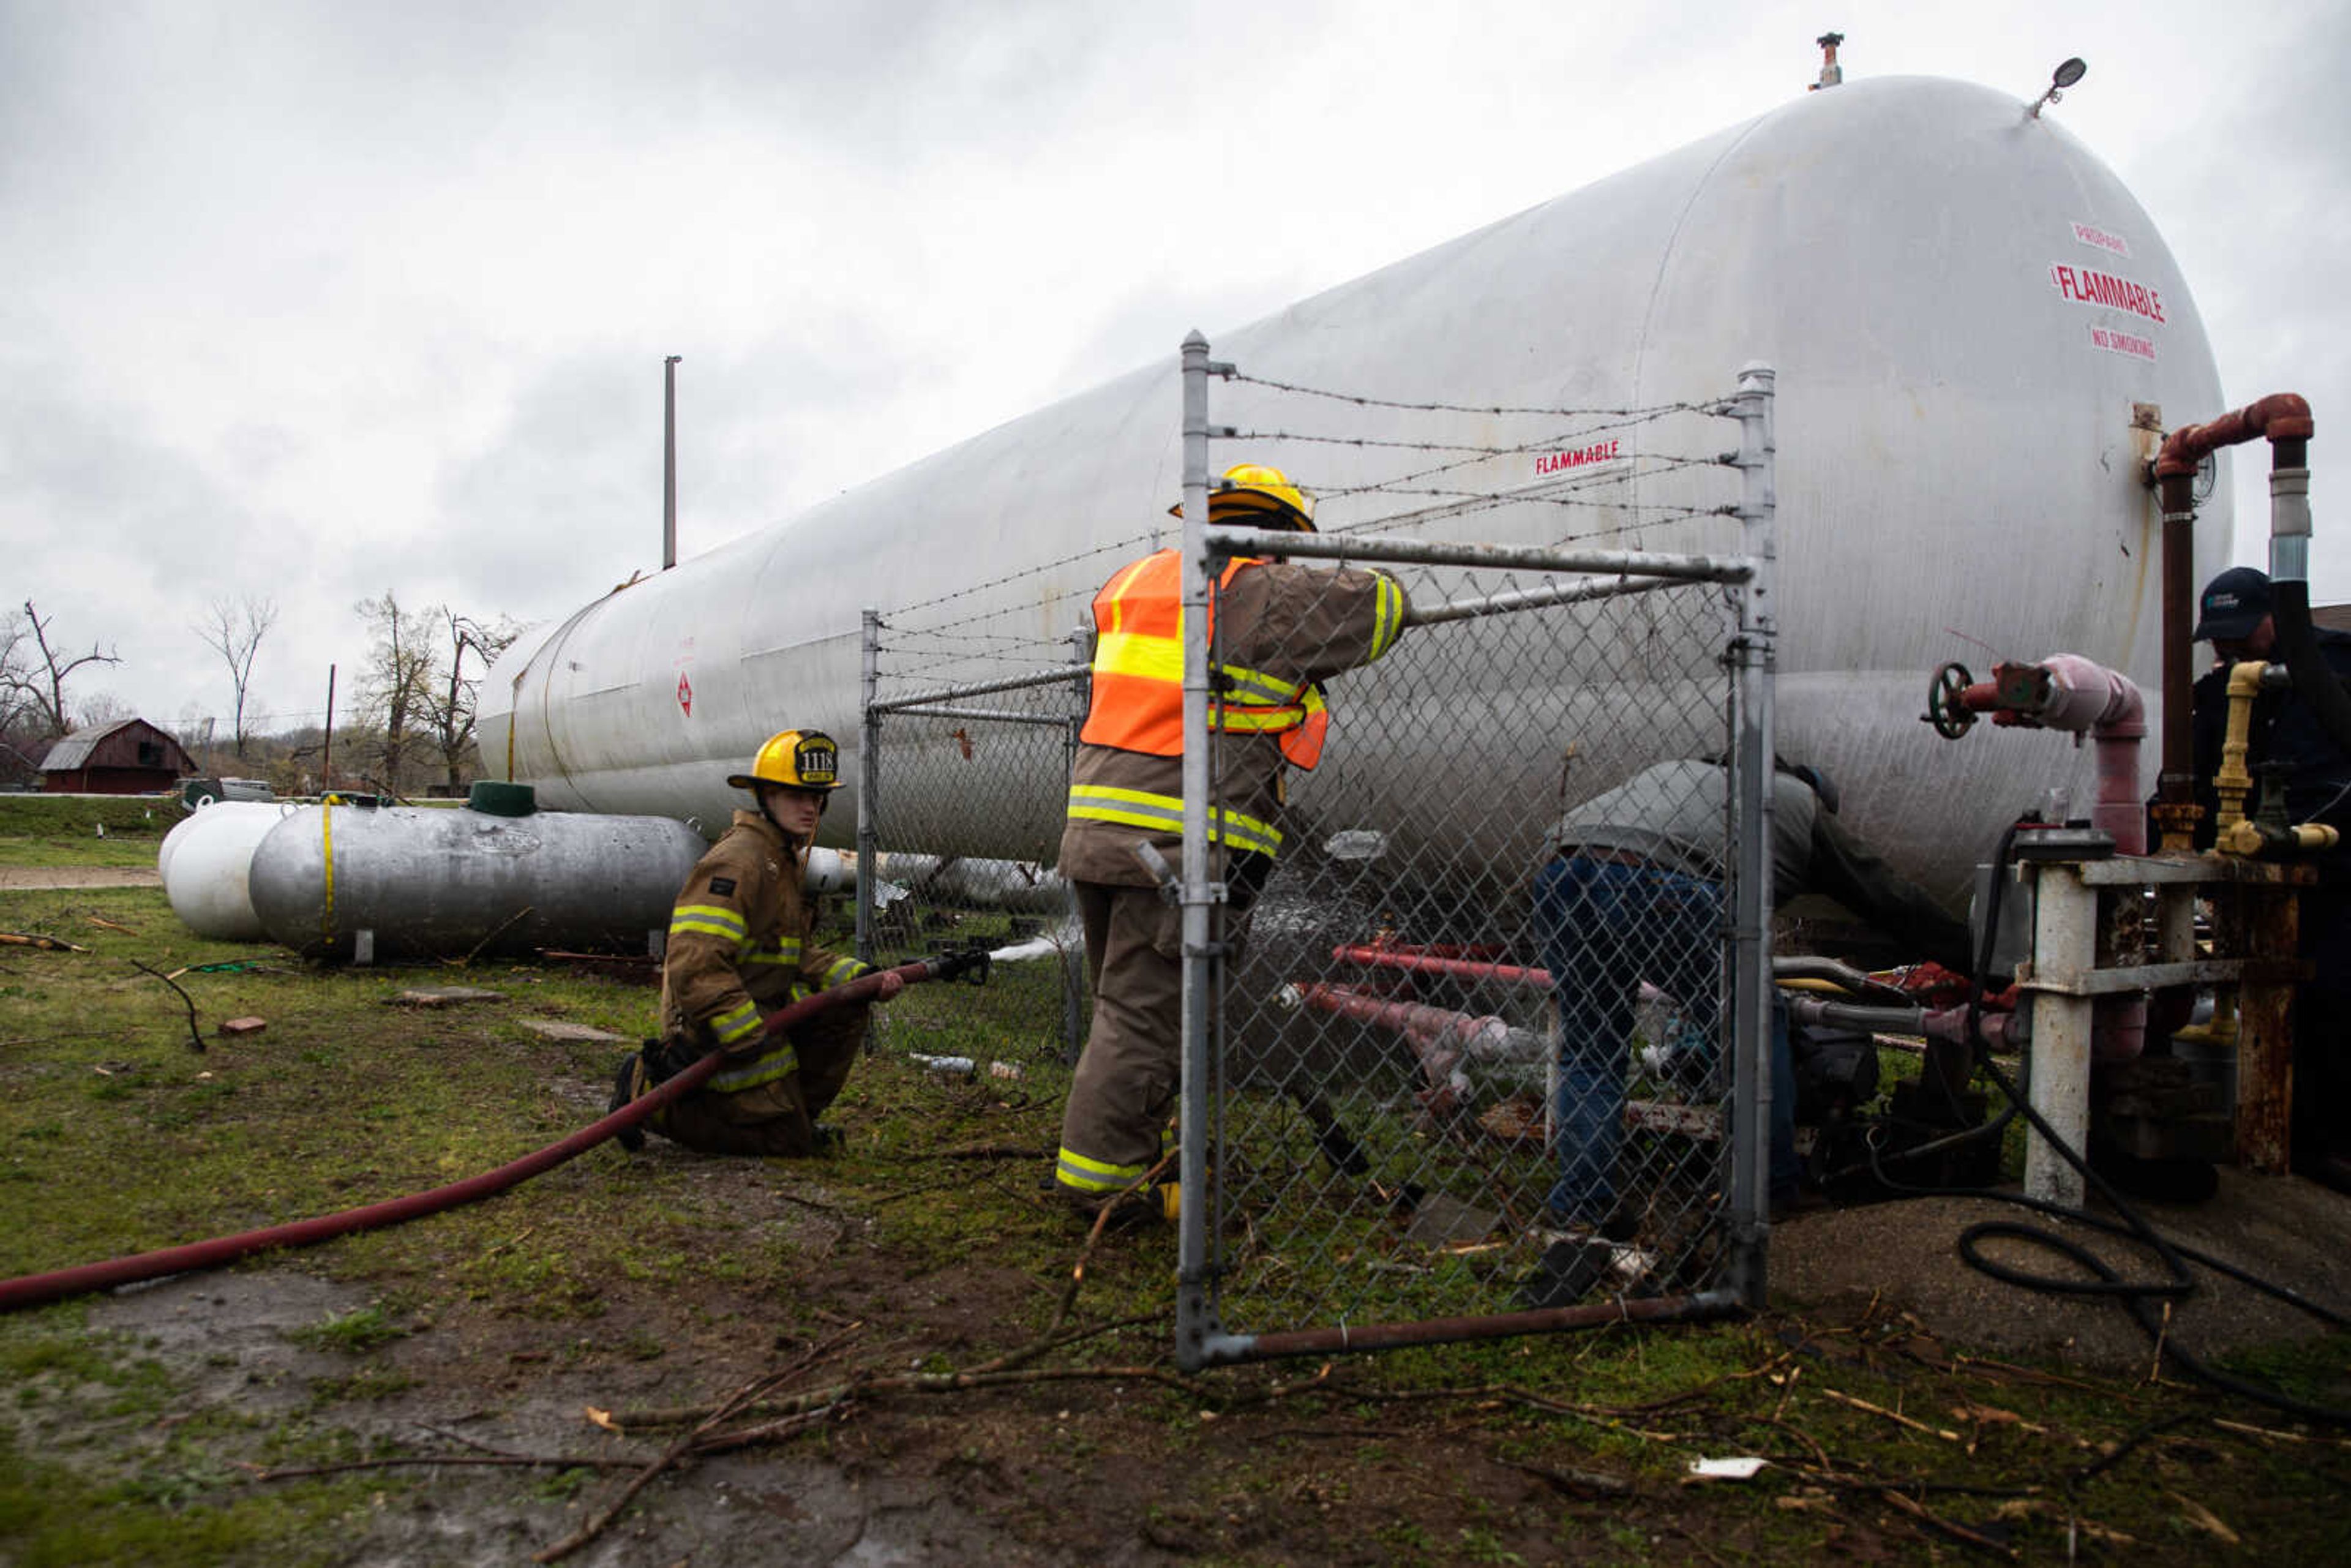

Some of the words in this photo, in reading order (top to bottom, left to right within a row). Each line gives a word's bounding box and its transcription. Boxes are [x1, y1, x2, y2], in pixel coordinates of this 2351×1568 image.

[2057, 266, 2165, 323] FLAMMABLE
[2093, 329, 2108, 348] NO
[2110, 331, 2154, 359] SMOKING
[1536, 440, 1620, 475] FLAMMABLE
[801, 752, 834, 771] 1118
